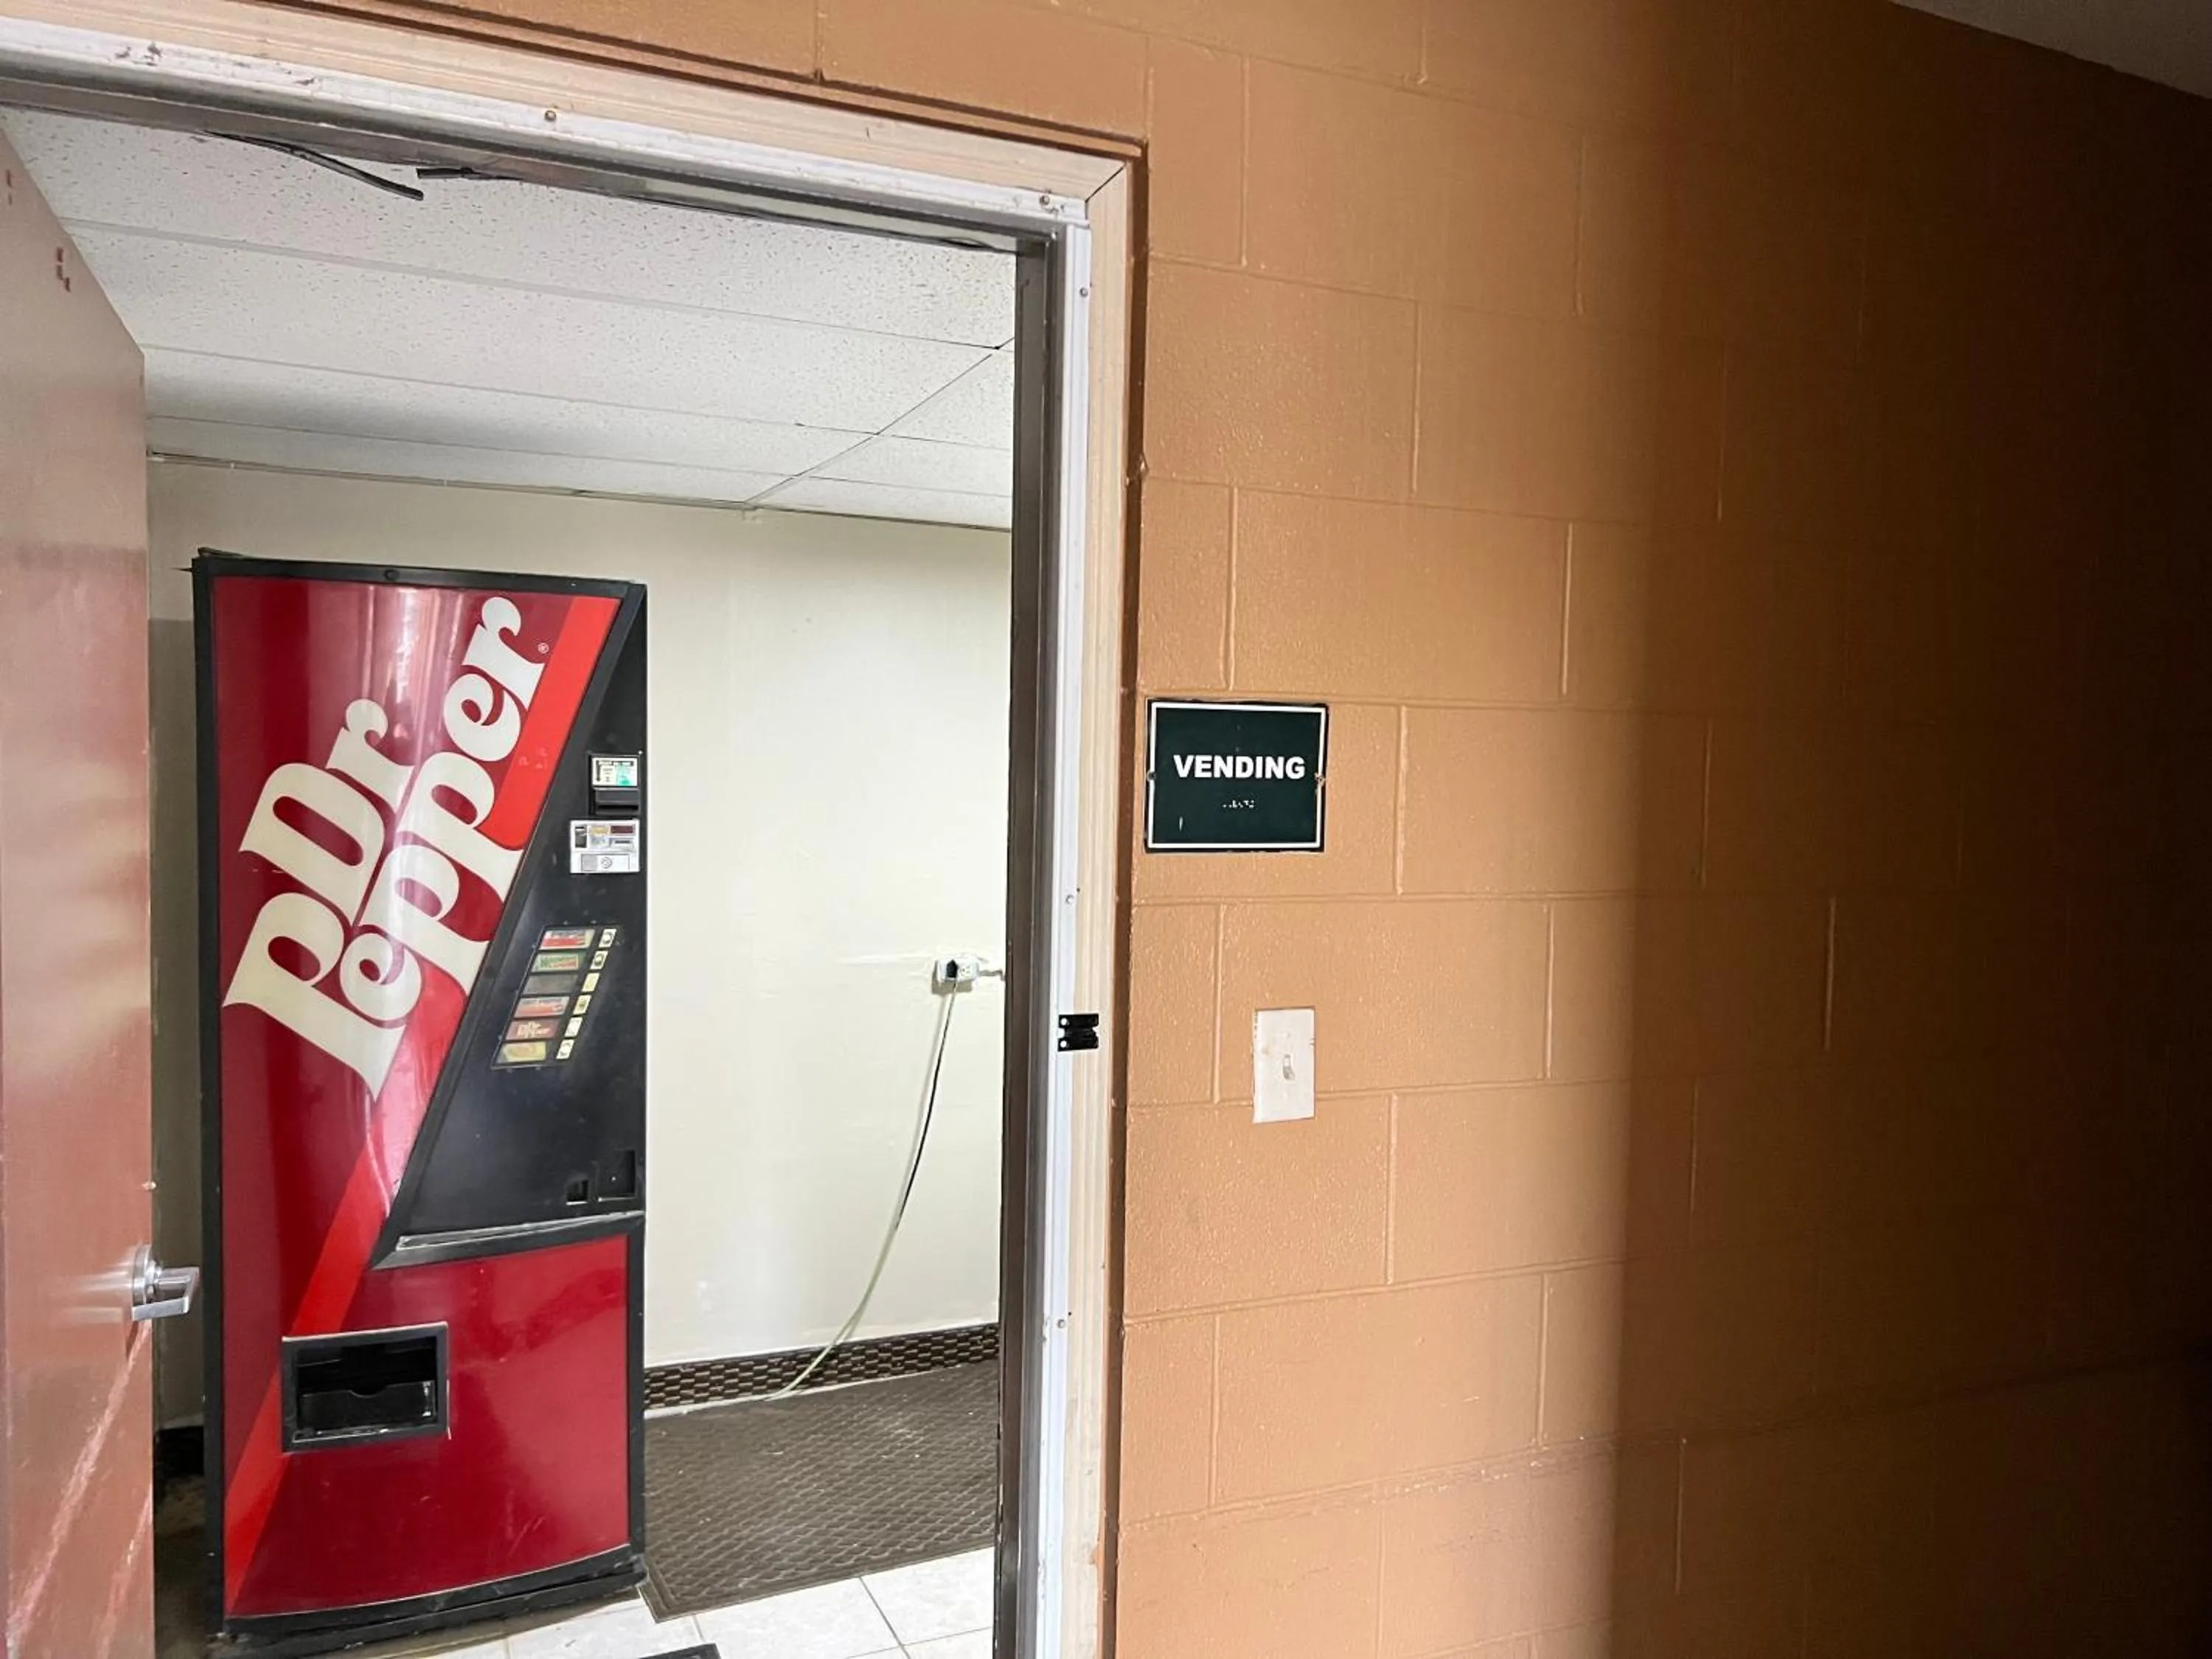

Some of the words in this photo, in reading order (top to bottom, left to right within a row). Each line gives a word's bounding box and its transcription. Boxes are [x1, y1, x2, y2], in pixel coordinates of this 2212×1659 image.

[222, 597, 547, 1102] Pepper
[238, 699, 415, 928] Dr
[1173, 754, 1306, 779] VENDING
